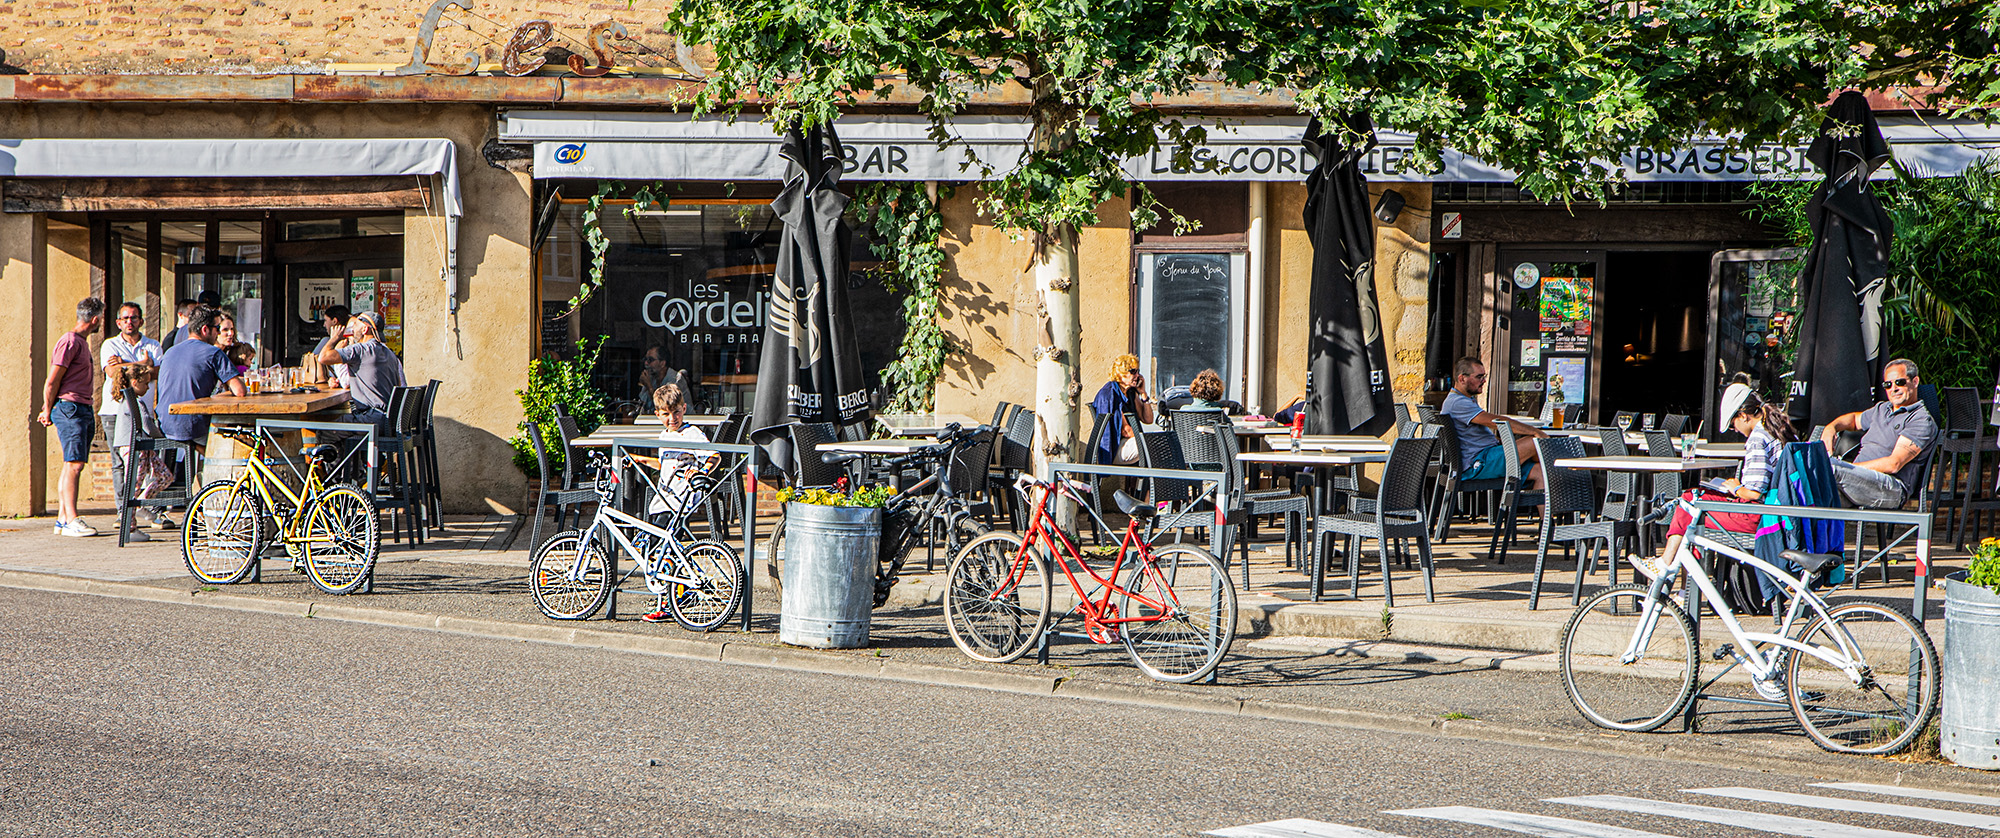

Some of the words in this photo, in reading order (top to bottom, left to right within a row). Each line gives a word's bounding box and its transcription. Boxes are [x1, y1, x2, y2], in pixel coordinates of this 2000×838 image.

[557, 147, 581, 160] C10
[841, 145, 909, 173] BAR
[1635, 147, 1826, 175] BRASSERI
[688, 279, 718, 298] les
[680, 333, 712, 343] BAR
